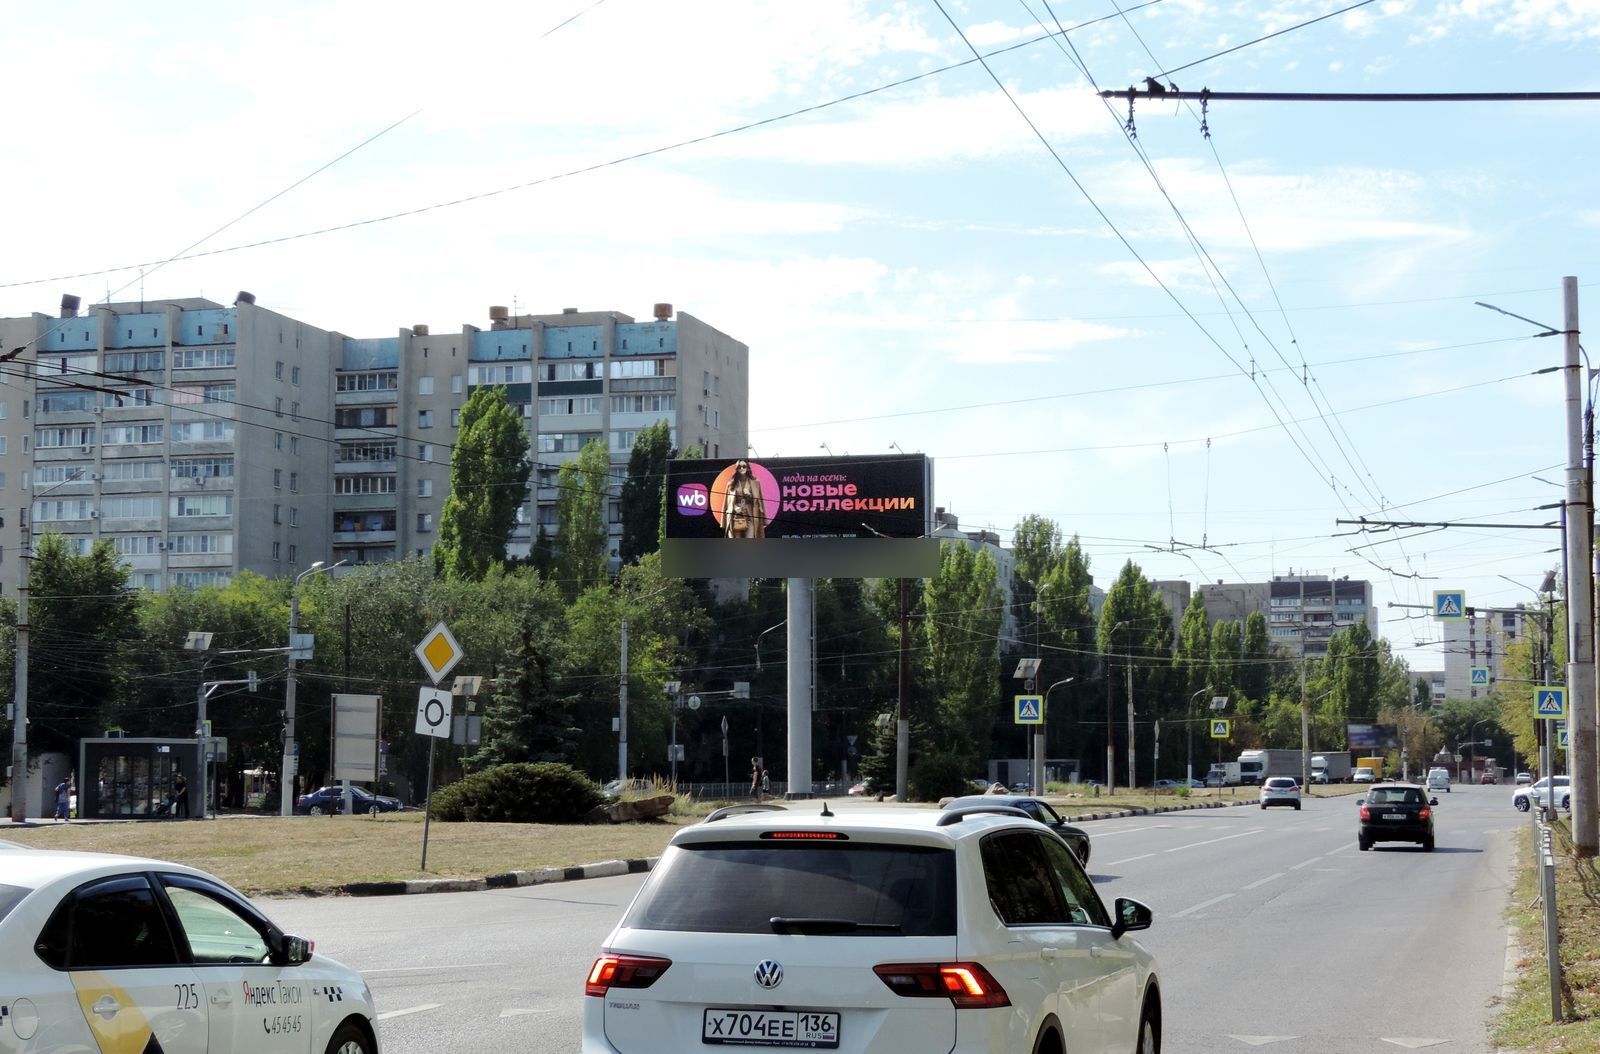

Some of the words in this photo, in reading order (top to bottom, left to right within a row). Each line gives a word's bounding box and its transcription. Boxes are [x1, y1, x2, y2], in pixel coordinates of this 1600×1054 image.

[782, 473, 805, 482] мода
[820, 473, 847, 482] осень:
[679, 490, 706, 506] wb
[174, 983, 199, 1010] 225
[243, 980, 276, 1007] Яндекс
[276, 979, 302, 1004] Такси
[800, 1014, 832, 1033] 136
[805, 1032, 822, 1040] RUS
